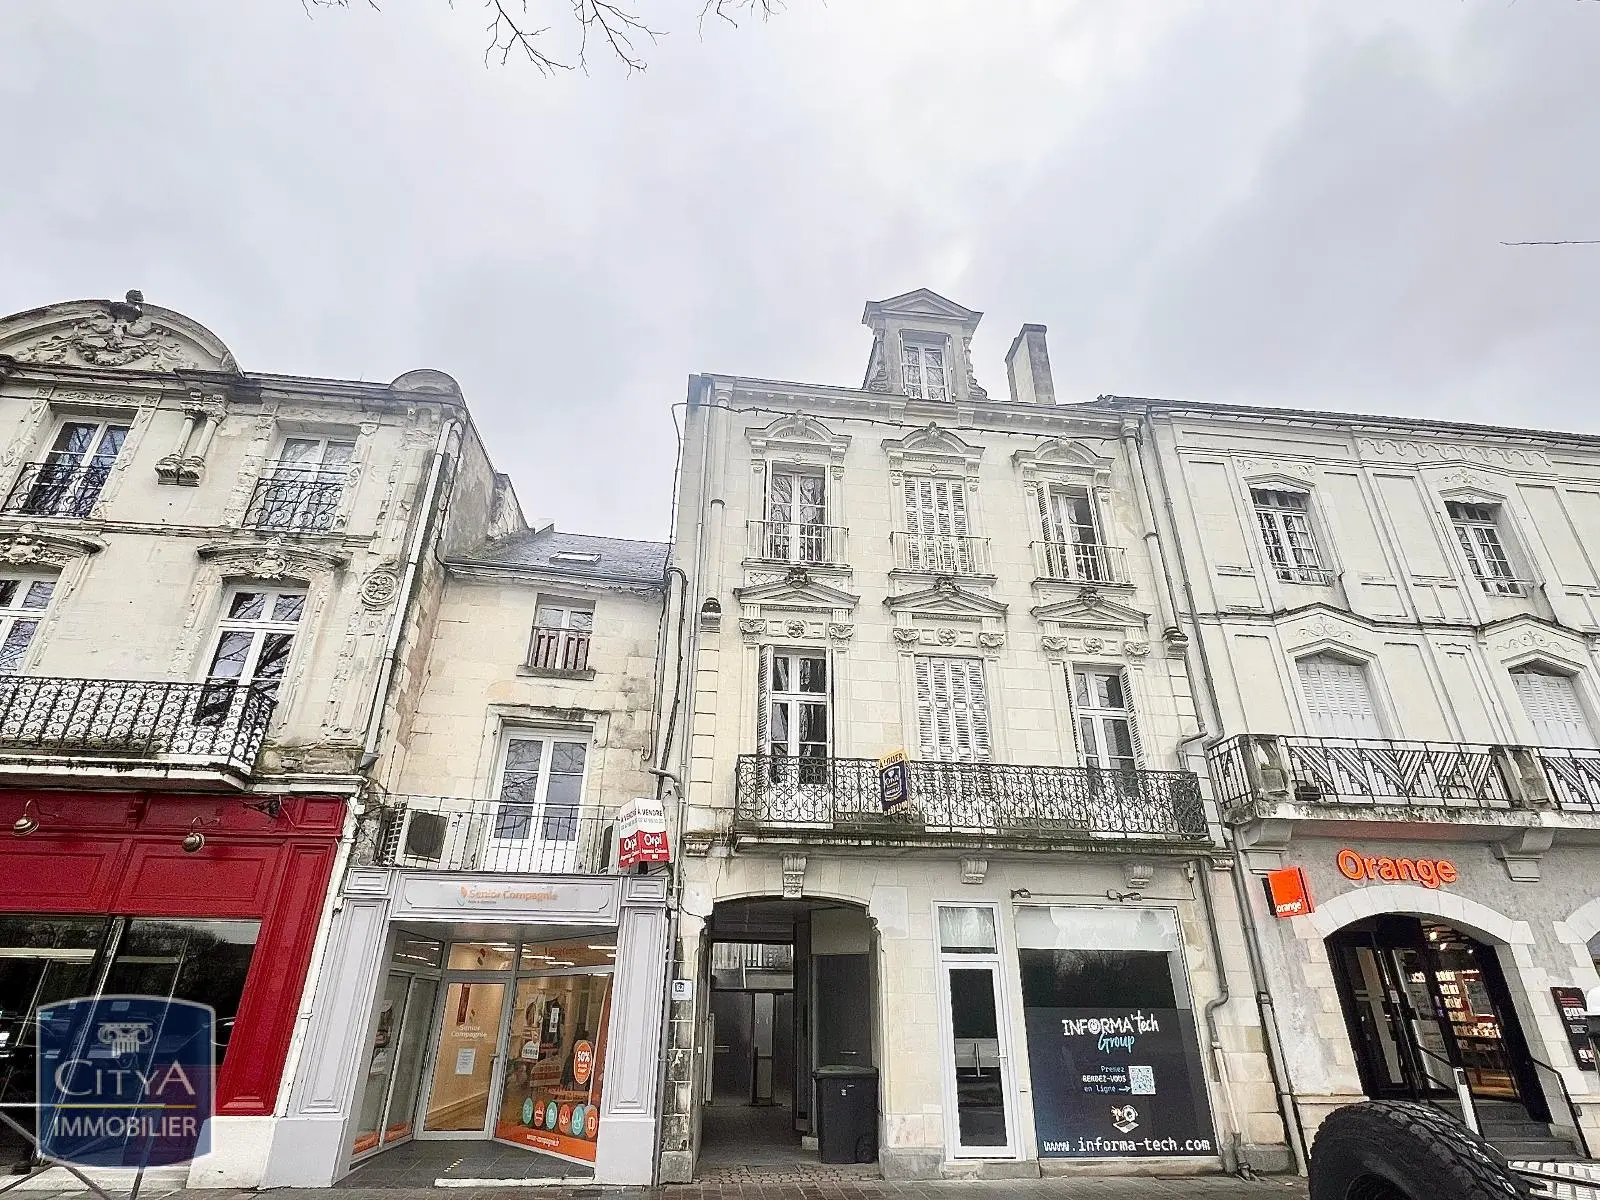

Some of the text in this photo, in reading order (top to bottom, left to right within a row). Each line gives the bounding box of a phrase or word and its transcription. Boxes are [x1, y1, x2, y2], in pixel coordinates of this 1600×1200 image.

[884, 753, 903, 766] LOUER
[642, 808, 663, 816] VENDRE
[644, 833, 662, 847] Orpi
[1337, 849, 1457, 889] Orange
[470, 889, 558, 902] Senior Compagnie
[1276, 901, 1302, 912] orange
[451, 1031, 487, 1039] Compagnie
[1097, 1033, 1135, 1053] Group
[1100, 1065, 1125, 1073] Prenez
[1082, 1075, 1127, 1083] RENDEZ-VOUS
[1096, 1084, 1116, 1093] ligne
[1043, 1136, 1211, 1152] www.informa-tech.com
